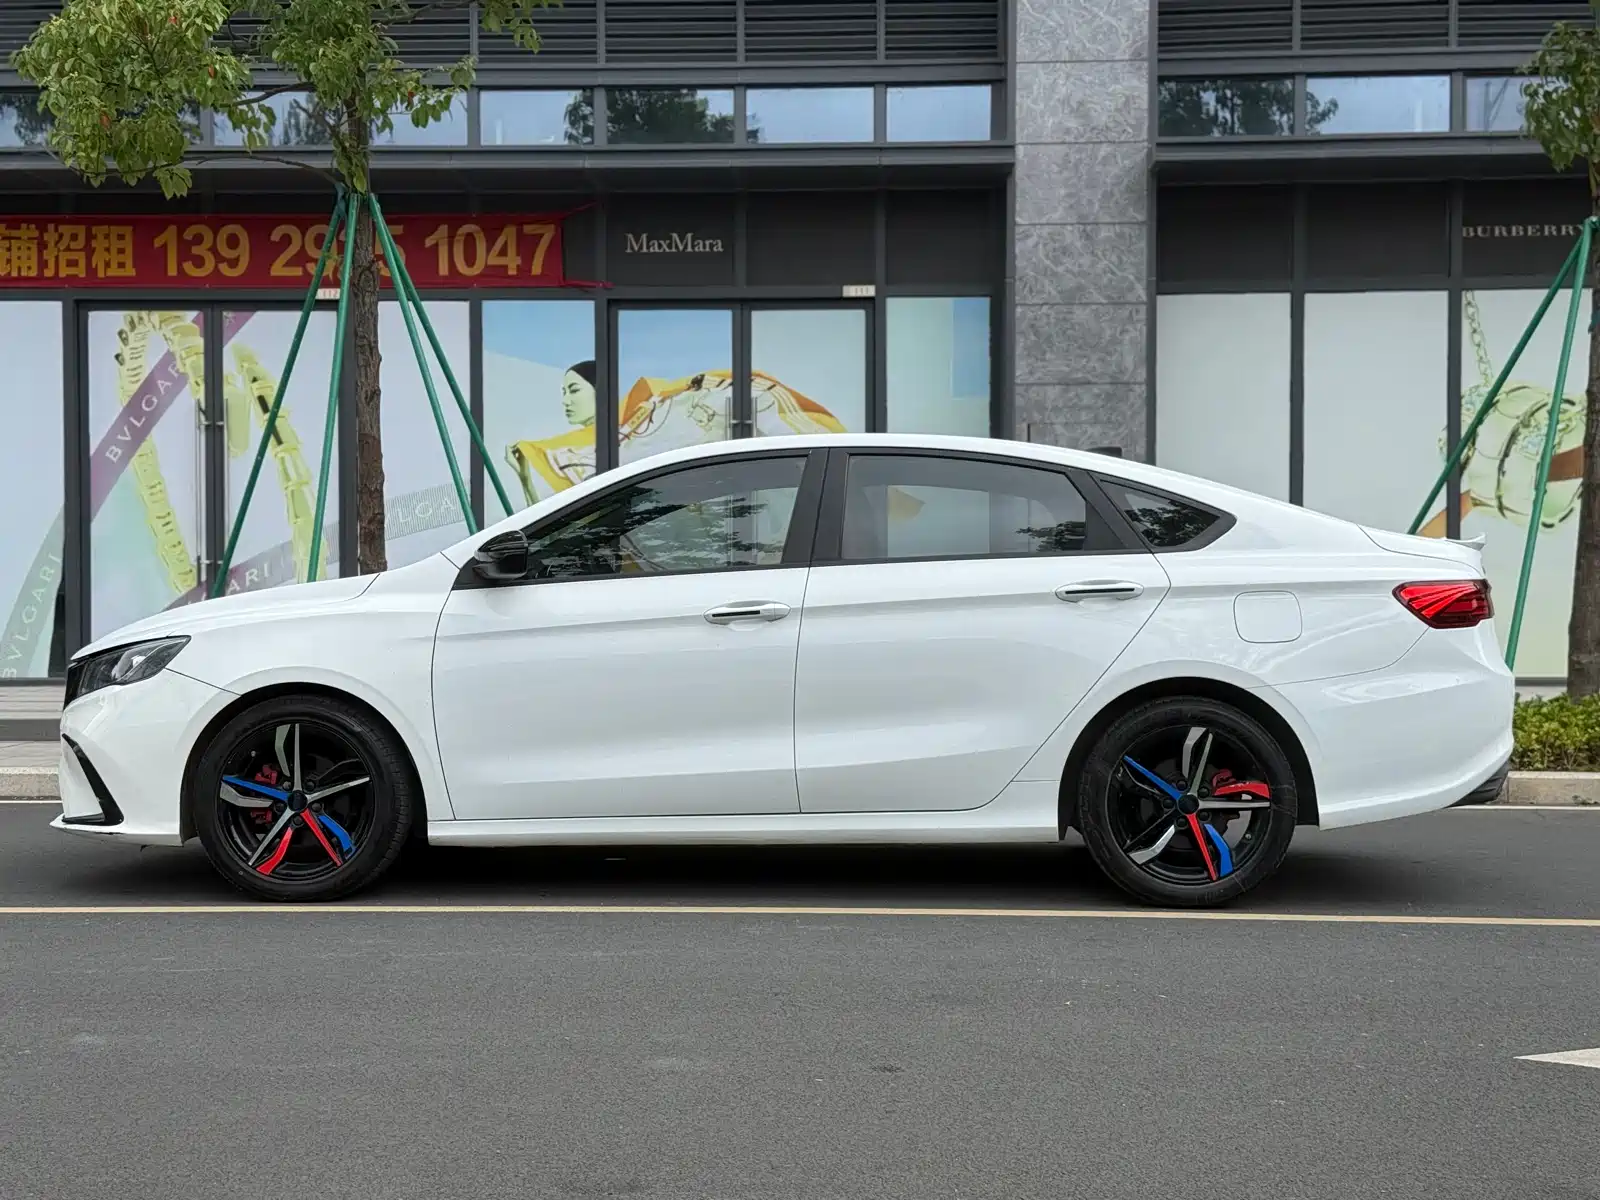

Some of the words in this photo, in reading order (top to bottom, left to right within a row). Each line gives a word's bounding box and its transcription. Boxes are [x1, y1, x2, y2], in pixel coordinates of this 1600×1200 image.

[0, 223, 136, 277] 铺招租
[154, 224, 250, 277] 139
[269, 224, 407, 277] 295
[424, 224, 556, 276] 1047
[625, 232, 724, 253] MaxMara
